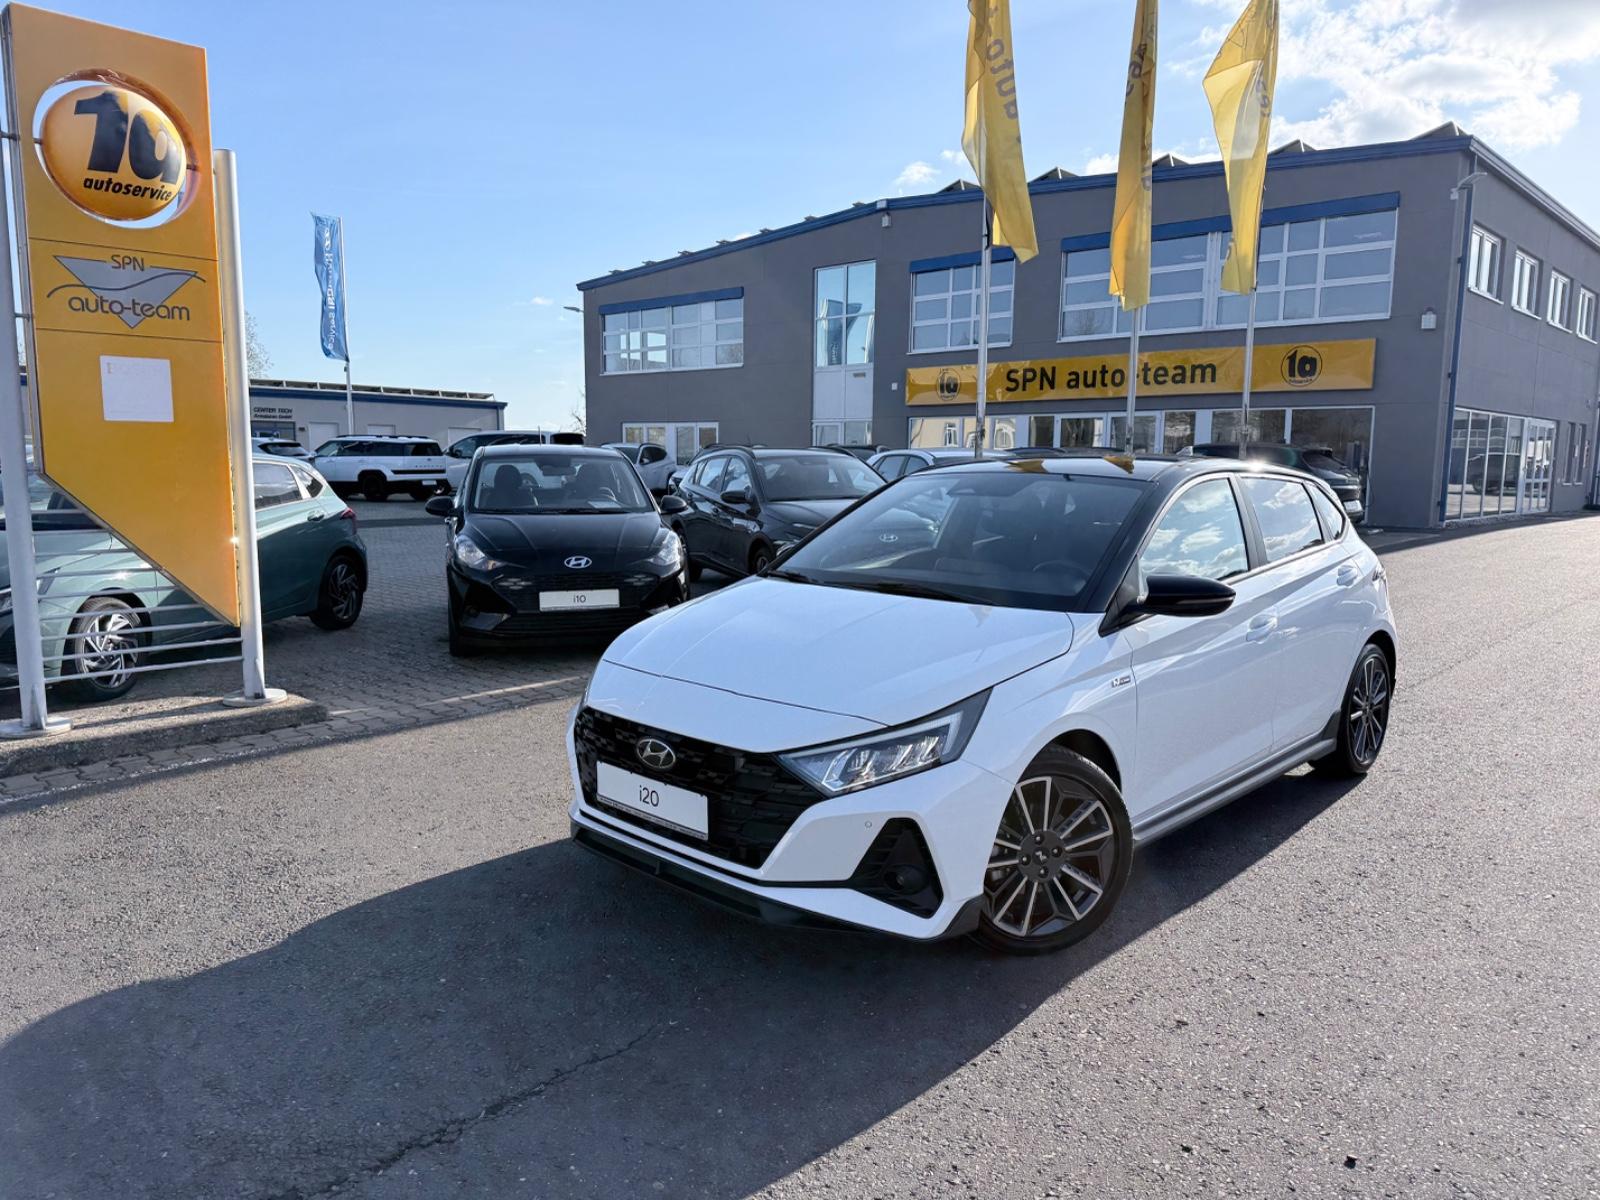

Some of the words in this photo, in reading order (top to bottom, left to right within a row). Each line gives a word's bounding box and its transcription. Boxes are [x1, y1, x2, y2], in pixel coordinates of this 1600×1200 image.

[74, 90, 182, 186] 1a
[83, 177, 172, 201] autoservice
[110, 254, 145, 272] SPN
[68, 296, 190, 321] auto-team
[1005, 366, 1057, 392] SPN
[1066, 362, 1217, 389] autoteam
[573, 594, 587, 603] i10
[639, 784, 660, 807] i20
